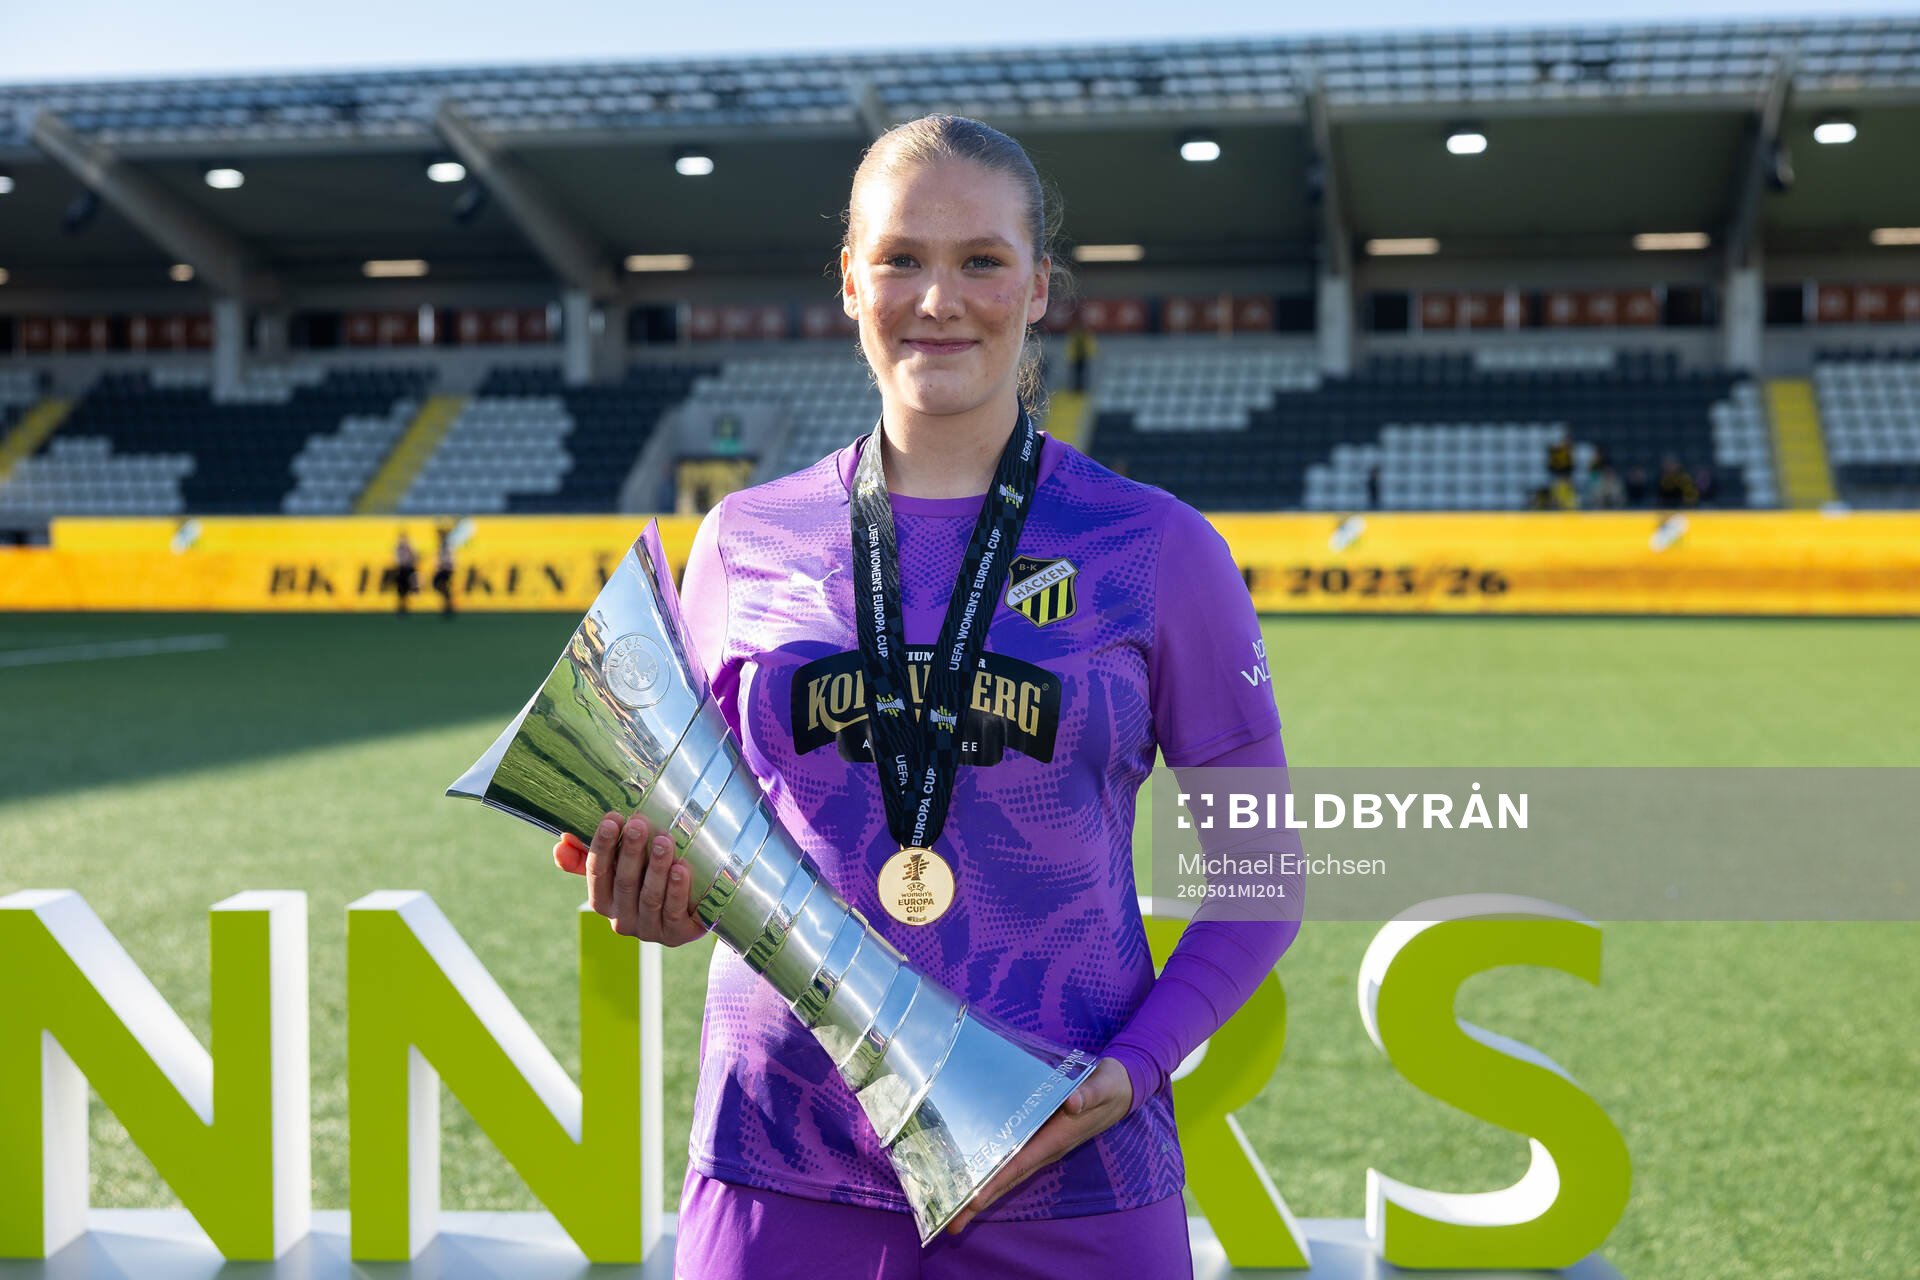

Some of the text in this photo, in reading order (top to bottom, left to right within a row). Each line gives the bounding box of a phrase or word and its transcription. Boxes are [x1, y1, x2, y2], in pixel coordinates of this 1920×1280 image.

[1020, 440, 1033, 461] UEFA
[868, 523, 880, 548] UEFA
[1013, 565, 1070, 599] HÄCKEN
[873, 594, 886, 633] EUROPA
[949, 642, 965, 671] UEFA
[973, 551, 995, 589] EUROPA
[987, 528, 1002, 549] CUP
[876, 635, 888, 658] CUP
[895, 754, 908, 786] UEFA
[911, 767, 936, 846] EUROPA CUP
[898, 898, 934, 906] EUROPA
